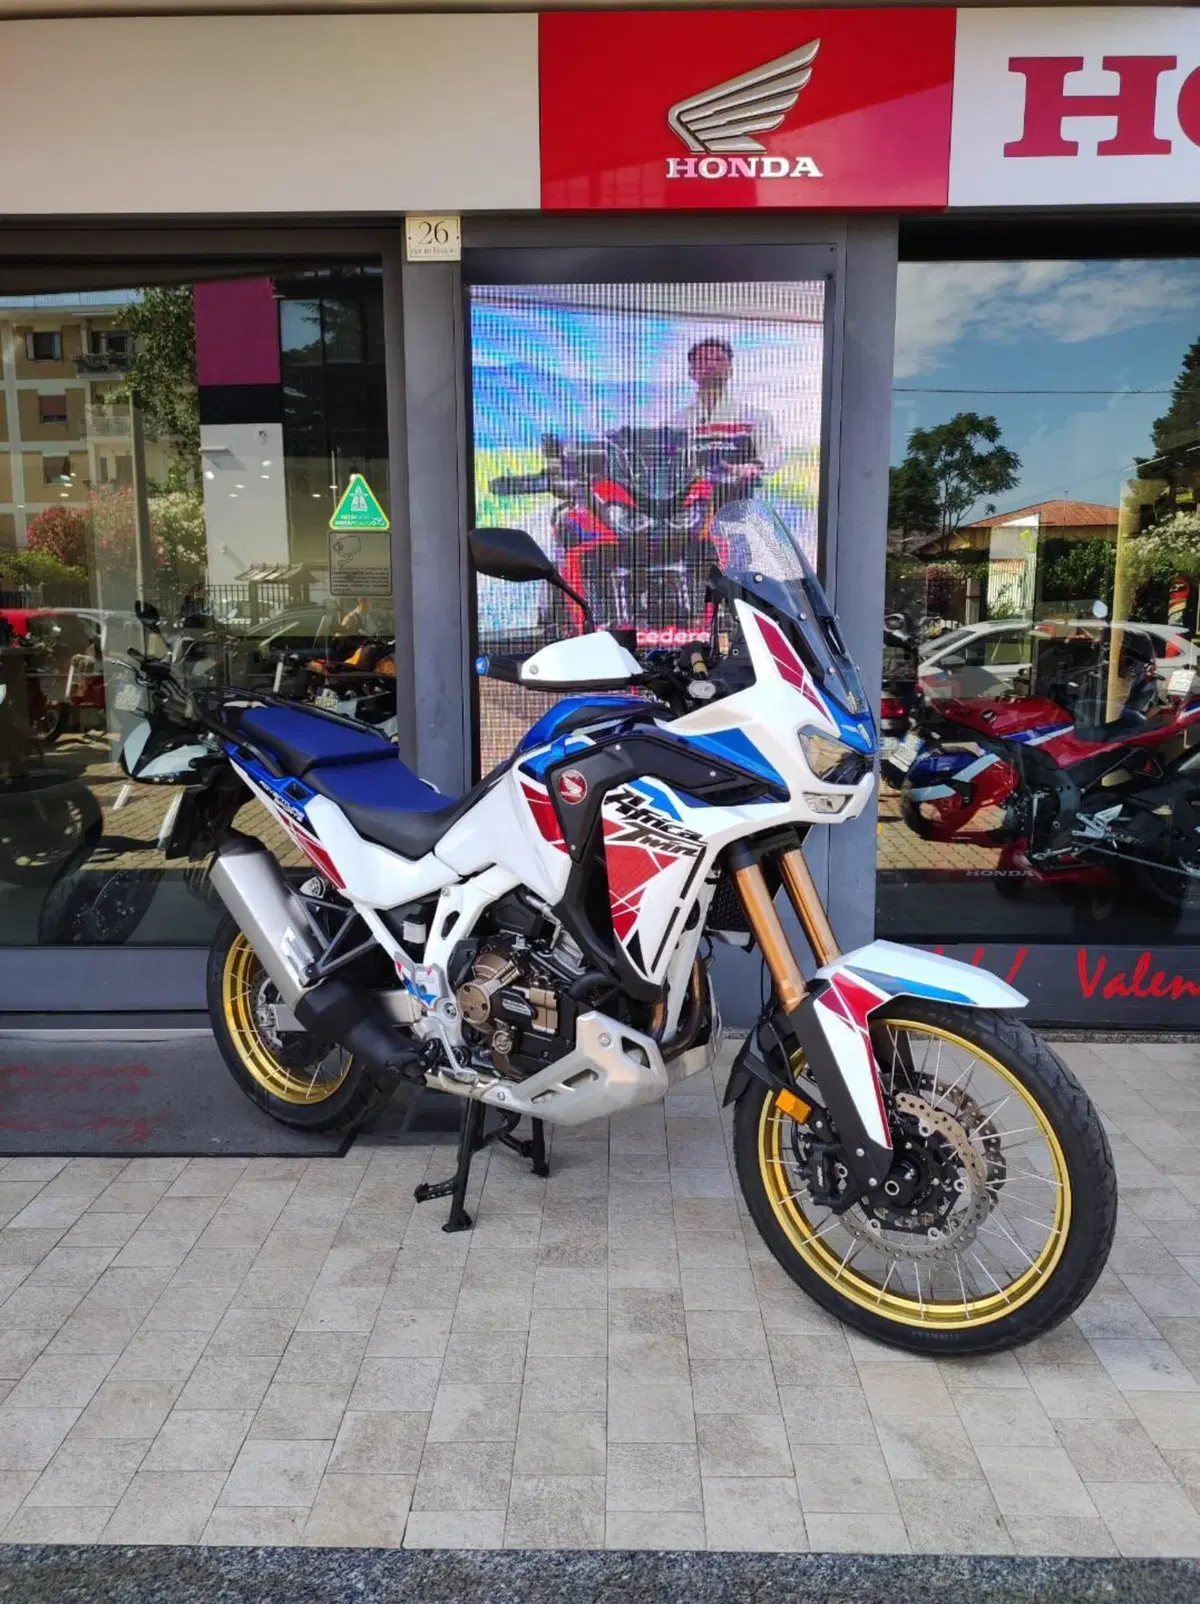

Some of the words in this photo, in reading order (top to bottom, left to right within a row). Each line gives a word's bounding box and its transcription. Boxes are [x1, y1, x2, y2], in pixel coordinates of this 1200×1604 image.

[1004, 56, 1200, 157] H
[666, 157, 823, 178] HONDA
[418, 221, 449, 245] 26
[603, 787, 704, 841] Africa
[606, 821, 709, 858] Twin
[966, 869, 1036, 877] HONDA
